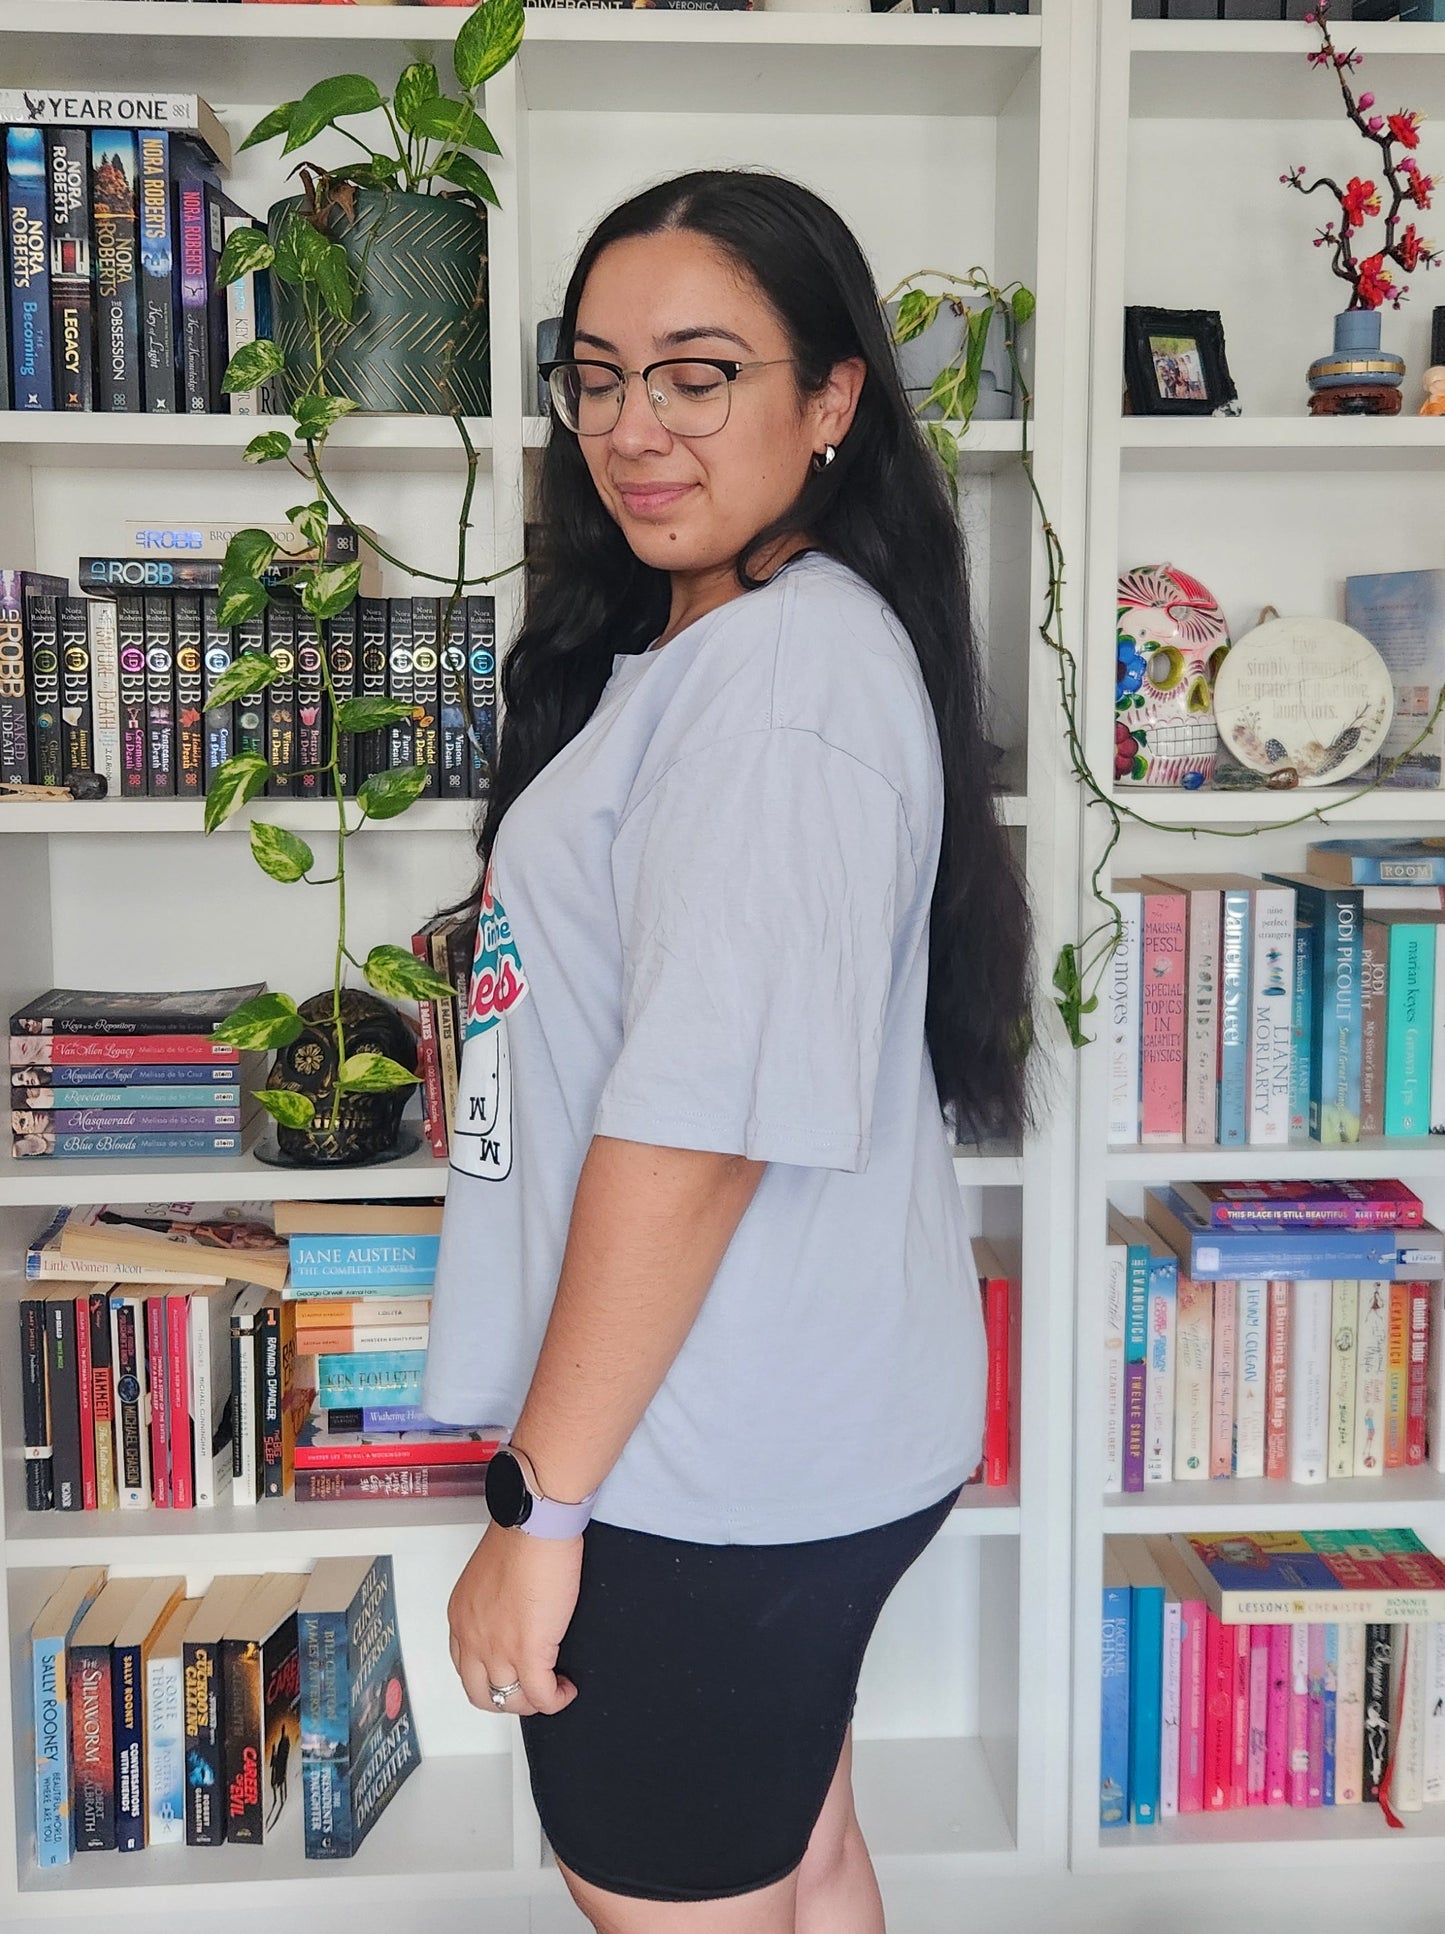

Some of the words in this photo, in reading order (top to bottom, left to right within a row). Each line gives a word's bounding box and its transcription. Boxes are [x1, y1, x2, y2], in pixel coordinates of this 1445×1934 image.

[668, 0, 720, 11] VERONICA
[48, 97, 112, 119] YEAR
[118, 100, 167, 120] ONE
[143, 138, 163, 177] NORA
[52, 146, 69, 224] ROBERTS
[68, 161, 82, 210] NORA
[145, 180, 165, 238] ROBERTS
[183, 192, 200, 221] NORA
[12, 207, 31, 288] ROBERTS
[29, 220, 44, 275] NORA
[97, 224, 116, 296] ROBERTS
[117, 239, 132, 283] NORA
[184, 225, 203, 275] ROBERTS
[20, 302, 37, 375] Becoming
[64, 309, 79, 373] LEGACY
[111, 307, 124, 381] OBSESSION
[109, 562, 174, 585] ROBB
[0, 624, 24, 698] ROBB
[32, 631, 58, 705] ROBB
[63, 631, 88, 704] ROBB
[95, 626, 116, 677] RAPTURE
[121, 631, 145, 704] ROBB
[146, 631, 172, 705] ROBB
[177, 631, 201, 704] ROBB
[298, 631, 321, 704] ROBB
[413, 630, 437, 704] ROBB
[470, 634, 494, 707] ROBB
[1, 705, 12, 720] IN
[98, 690, 116, 730] DEATH
[2, 722, 14, 765] DEATH
[14, 713, 25, 760] NAKED
[310, 730, 320, 765] Betrayal
[401, 735, 411, 761] Purity
[427, 730, 436, 764] Divided
[455, 734, 463, 766] Visions
[1384, 865, 1429, 877] ROOM
[1146, 923, 1182, 934] MARISHA
[1335, 903, 1353, 941] JODI
[1146, 937, 1183, 953] PESSL
[1225, 898, 1249, 986] Danielle
[1372, 963, 1385, 996] JODI
[1407, 941, 1417, 985] marian
[1109, 962, 1130, 1025] moyes
[1145, 984, 1183, 996] SPECIAL
[1196, 955, 1213, 1040] MORBIDS
[1336, 947, 1352, 1023] PICOULT
[421, 1007, 432, 1040] MATES
[1145, 1000, 1183, 1015] TOPICS
[1154, 1018, 1171, 1032] IN
[1223, 990, 1244, 1047] Steel
[1403, 989, 1419, 1022] keyes
[1144, 1035, 1182, 1047] CALAMITY
[1144, 1050, 1182, 1062] PHYSICS
[1272, 1025, 1289, 1096] LIANE
[427, 1065, 435, 1077] 100
[1255, 1007, 1270, 1116] MORIARTY
[1299, 1057, 1309, 1095] LIANE
[428, 1079, 437, 1100] Sudoku
[1364, 1072, 1374, 1104] Keeper
[69, 1112, 135, 1131] Masquerade
[430, 1101, 439, 1123] Puzzles
[64, 1136, 93, 1150] Blue
[96, 1136, 137, 1150] Bloods
[1228, 1210, 1245, 1218] THIS
[1248, 1210, 1272, 1218] PLACE
[1274, 1210, 1281, 1218] IS
[1283, 1210, 1304, 1218] STILL
[1306, 1210, 1348, 1218] BEAUTIFUL
[1355, 1211, 1373, 1219] XIXI
[44, 1260, 69, 1272] Little
[71, 1261, 109, 1272] Women
[114, 1264, 142, 1273] Alcott
[296, 1249, 342, 1264] JANE
[347, 1247, 416, 1262] AUSTEN
[322, 1266, 372, 1275] COMPLETE
[377, 1265, 414, 1273] NOVELS
[1131, 1269, 1146, 1343] EVANOVICH
[1246, 1289, 1259, 1326] JENNY
[1413, 1298, 1427, 1330] about
[1273, 1307, 1287, 1364] Burning
[1412, 1342, 1427, 1362] boy
[266, 1336, 277, 1376] RAYMOND
[1244, 1332, 1258, 1383] COLGAN
[94, 1371, 109, 1419] HAMMETT
[327, 1374, 353, 1386] KEN
[359, 1370, 420, 1386] FOLLETT
[1108, 1359, 1118, 1415] ELIZABETH
[1130, 1376, 1142, 1417] TWELVE
[1274, 1369, 1286, 1392] the
[267, 1379, 277, 1420] CHANDLER
[370, 1412, 404, 1422] Wuthering
[1271, 1397, 1285, 1428] Map
[98, 1427, 108, 1443] The
[125, 1406, 138, 1446] MICHAEL
[1108, 1420, 1117, 1462] GILBERT
[1130, 1423, 1140, 1457] SHARP
[99, 1445, 108, 1479] Maltese
[127, 1448, 139, 1484] CHABON
[264, 1437, 274, 1465] SLEEP
[273, 1442, 281, 1457] BIG
[100, 1480, 109, 1505] Falcon
[353, 1574, 388, 1645] CLINTON
[1239, 1603, 1290, 1613] LESSONS
[1308, 1603, 1372, 1612] CHEMISTRY
[81, 1659, 97, 1670] THE
[1102, 1618, 1114, 1678] JOHNS
[1116, 1618, 1126, 1675] RACHAEL
[42, 1656, 55, 1693] SALLY
[124, 1655, 133, 1686] SALLY
[196, 1649, 208, 1727] CUCKOO'S
[124, 1687, 134, 1729] ROONEY
[152, 1667, 165, 1731] THOMAS
[165, 1676, 178, 1720] ROSIE
[185, 1666, 198, 1737] CALLING
[326, 1661, 336, 1720] CLINTON
[43, 1700, 58, 1761] ROONEY
[82, 1670, 101, 1763] SILKWORM
[120, 1749, 130, 1774] WITH
[130, 1743, 140, 1817] CONVERSATIONS
[243, 1747, 258, 1805] CAREER
[43, 1779, 51, 1804] WHERE
[53, 1772, 61, 1812] BEAUTIFUL
[120, 1776, 130, 1812] FRIENDS
[230, 1784, 244, 1817] EVIL
[356, 1740, 412, 1828] DAUGHTER
[44, 1826, 52, 1842] YOU
